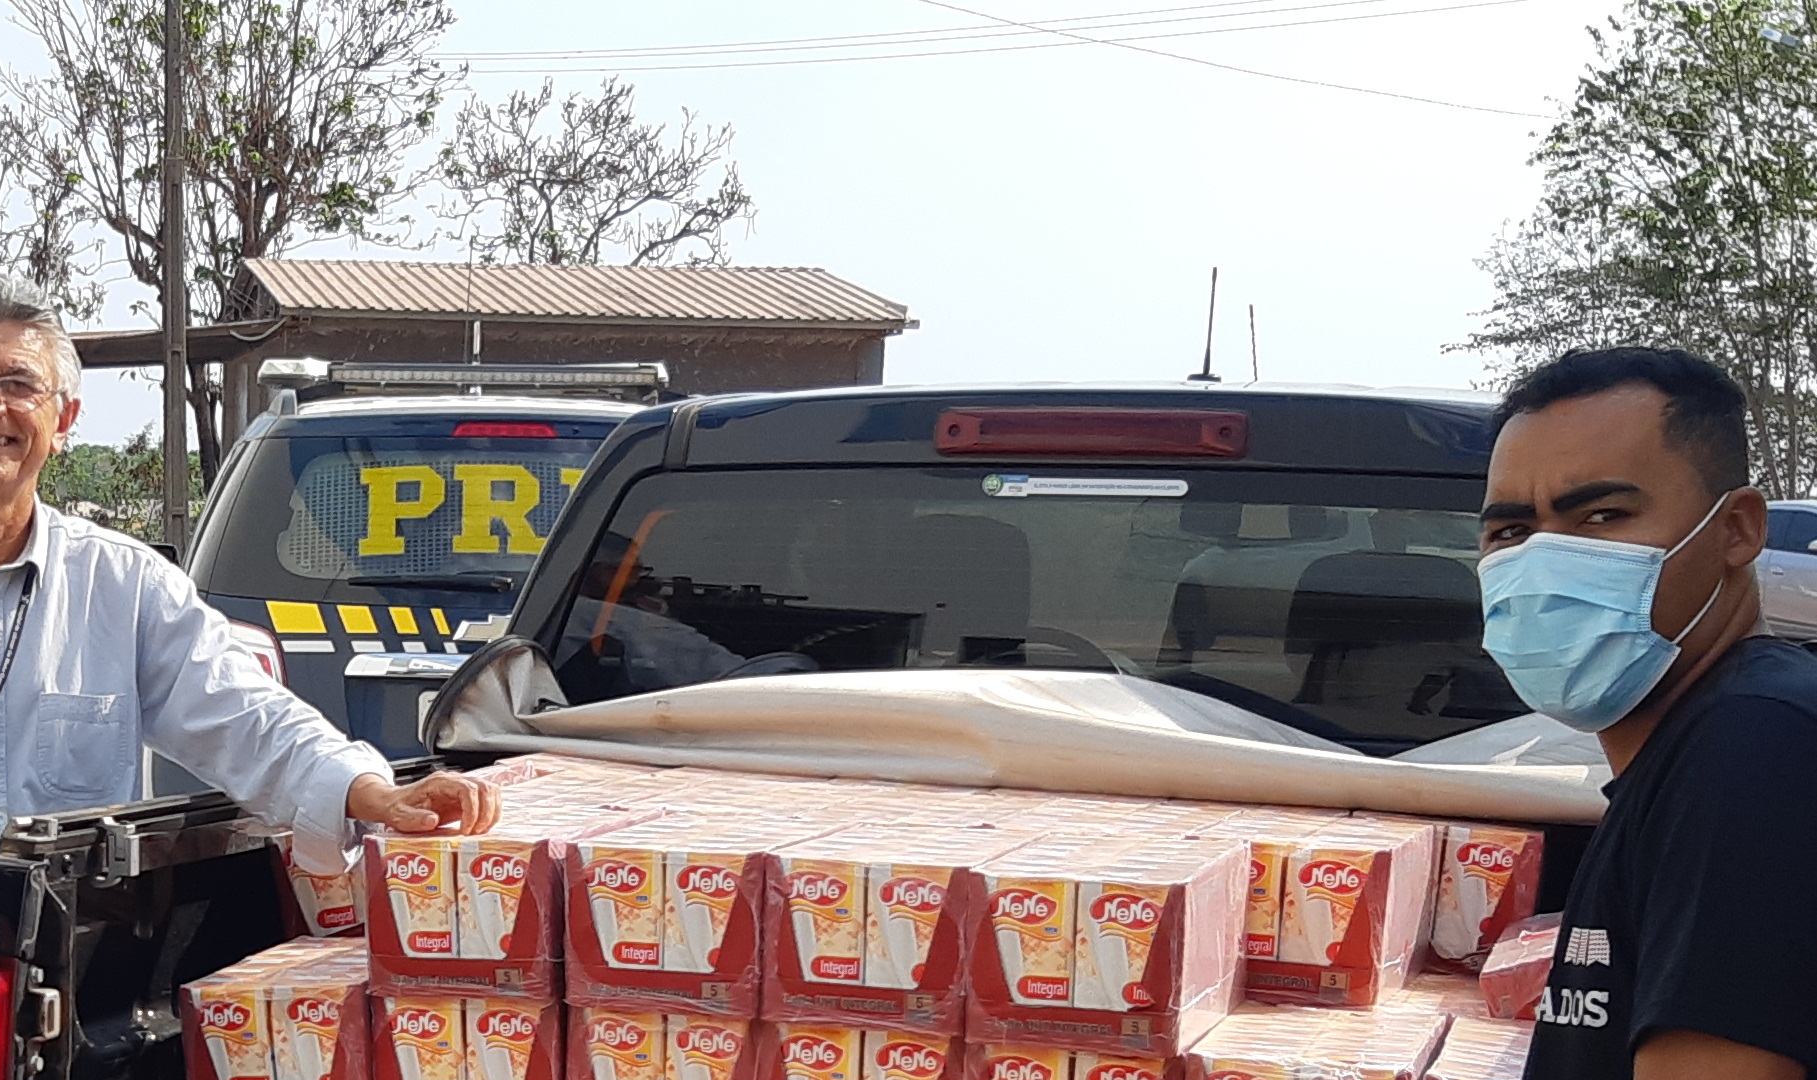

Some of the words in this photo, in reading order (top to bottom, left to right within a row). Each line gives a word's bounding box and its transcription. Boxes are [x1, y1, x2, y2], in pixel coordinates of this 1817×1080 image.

[415, 932, 450, 952] Integral
[1247, 937, 1274, 955] egral
[620, 945, 657, 963] Integral
[503, 971, 512, 983] 5
[820, 959, 858, 978] Integral
[1027, 979, 1067, 998] Integral
[1329, 974, 1337, 986] 5
[710, 985, 718, 997] 5
[916, 996, 925, 1009] 5
